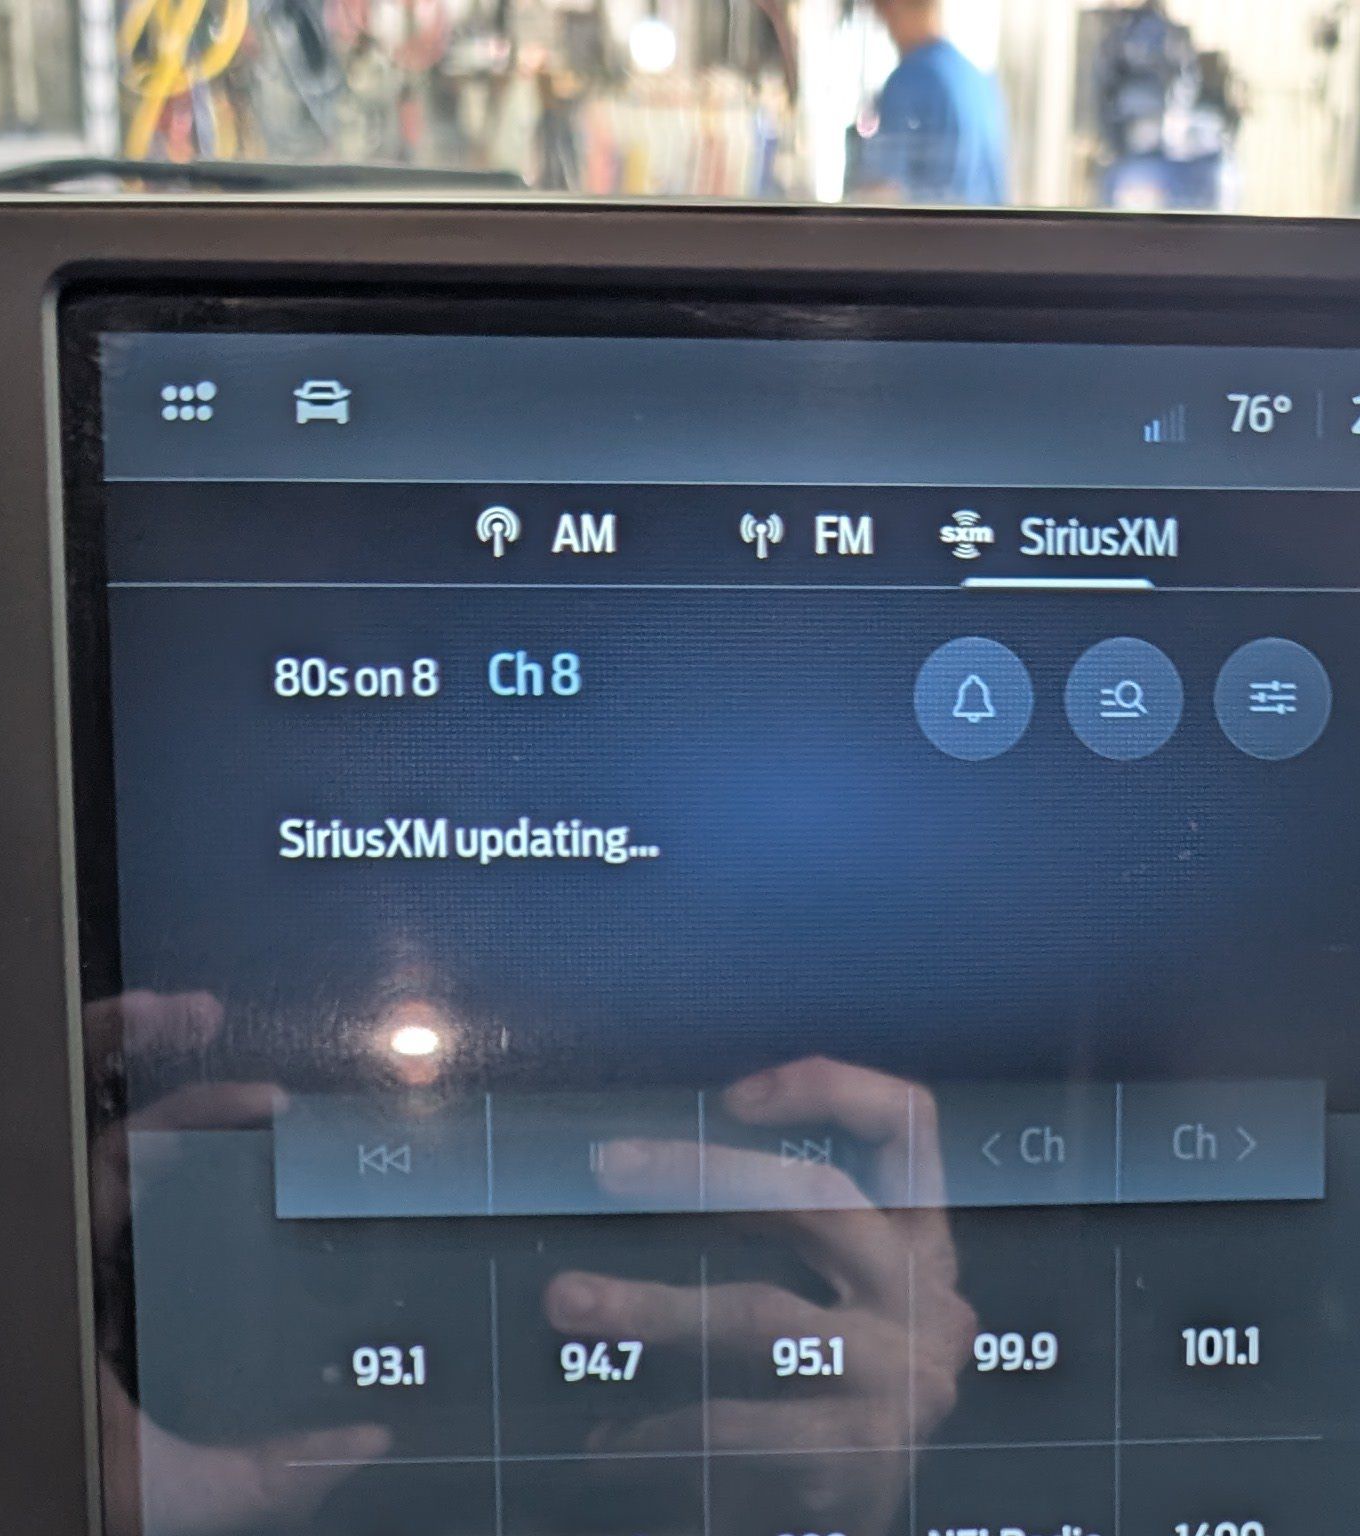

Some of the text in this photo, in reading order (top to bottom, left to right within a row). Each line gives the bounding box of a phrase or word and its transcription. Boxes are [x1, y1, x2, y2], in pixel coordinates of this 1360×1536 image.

[1227, 393, 1292, 433] 76°
[551, 513, 616, 553] AM
[815, 514, 873, 555] FM
[1020, 517, 1177, 557] SiriusXM
[274, 657, 439, 697] 80s on 8
[488, 650, 581, 696] Ch 8
[279, 817, 660, 865] SiriusXM updating...
[1021, 1127, 1065, 1165] Ch
[1173, 1124, 1217, 1162] Ch
[352, 1345, 426, 1386] 93.1
[560, 1340, 643, 1381] 94.7
[772, 1336, 844, 1376] 95.1
[973, 1332, 1058, 1372] 99.9
[1182, 1326, 1259, 1366] 101.1
